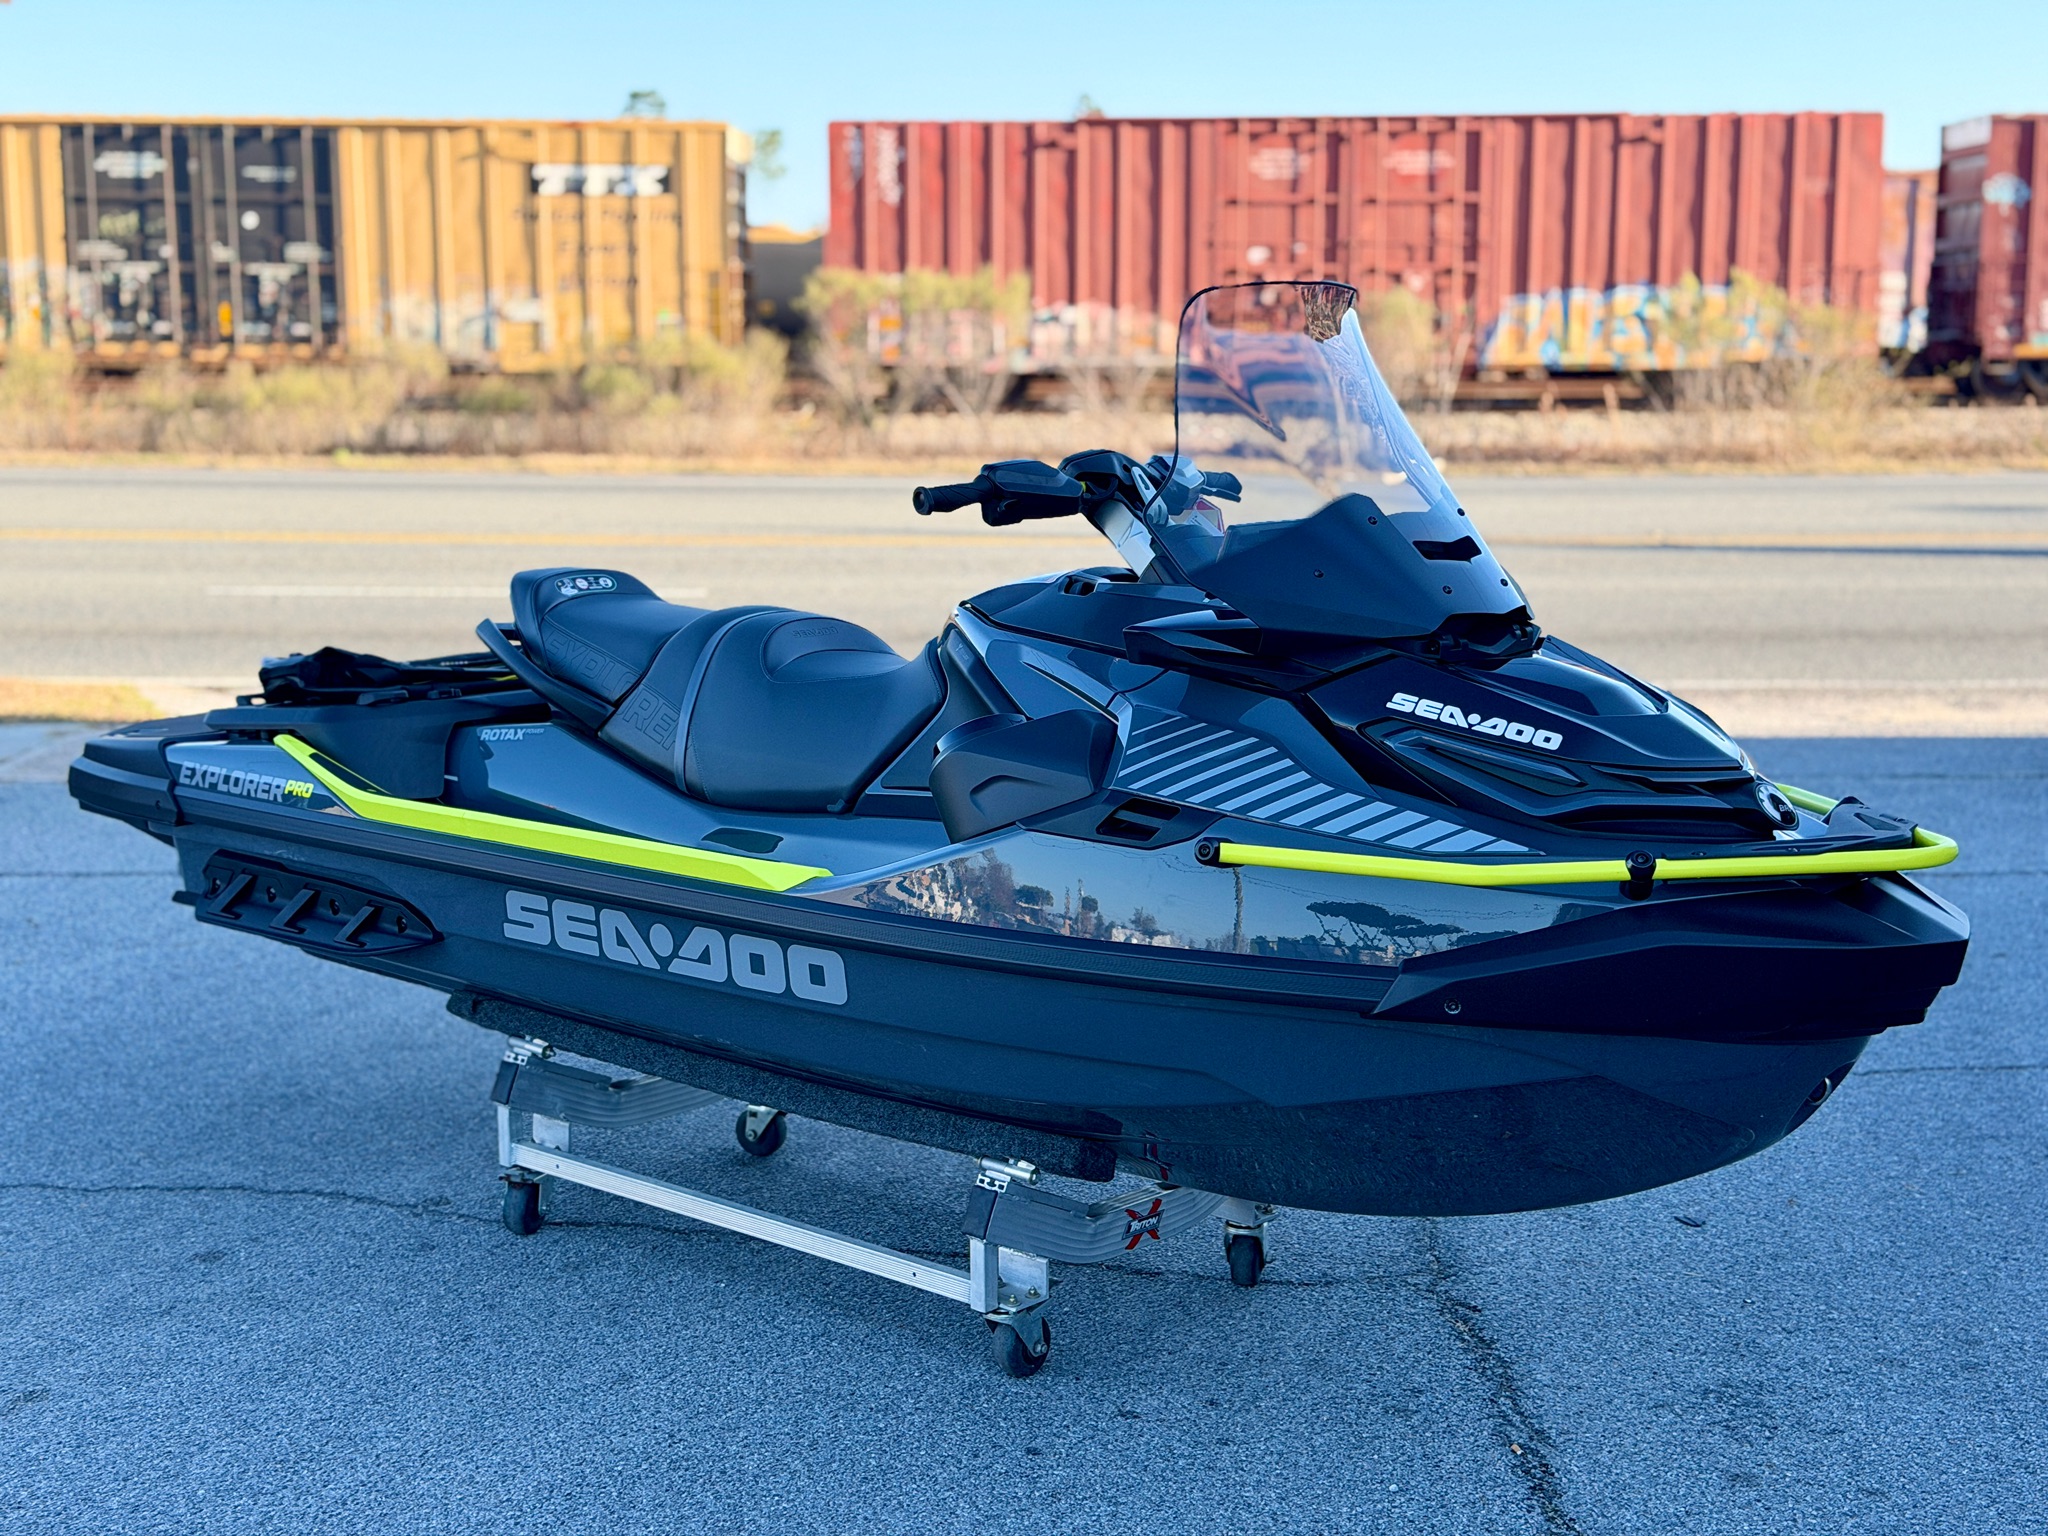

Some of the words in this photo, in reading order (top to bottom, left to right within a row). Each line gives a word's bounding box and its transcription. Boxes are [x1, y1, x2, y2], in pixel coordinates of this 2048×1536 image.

[480, 728, 526, 740] ROTAX
[179, 761, 287, 802] EXPLORER
[285, 780, 314, 798] PRO
